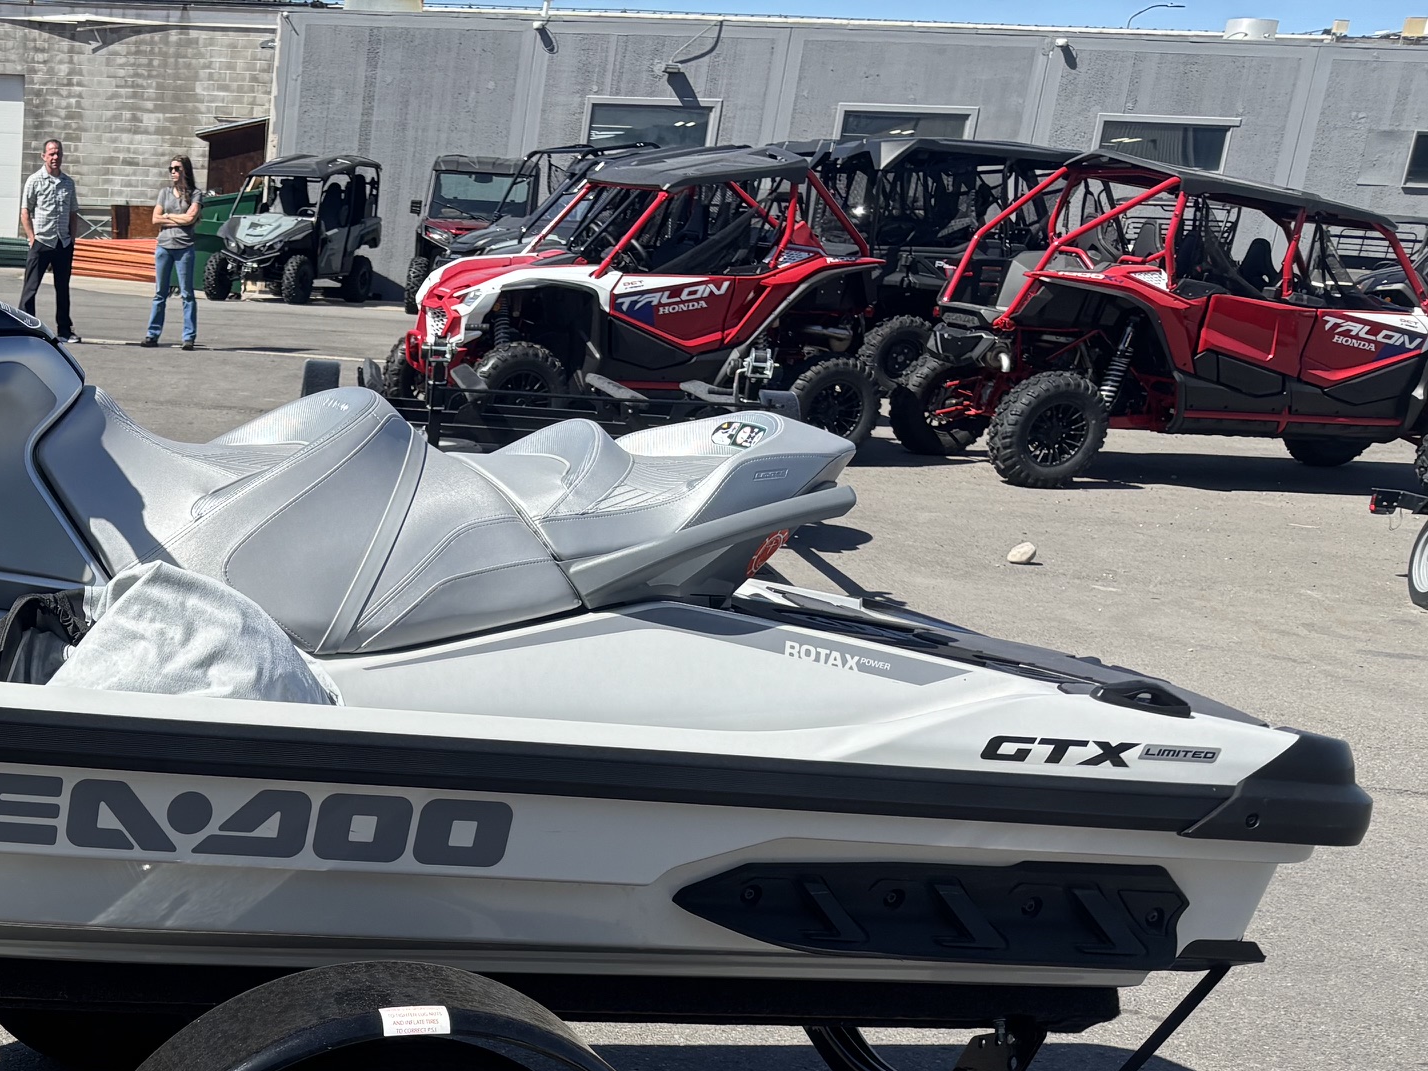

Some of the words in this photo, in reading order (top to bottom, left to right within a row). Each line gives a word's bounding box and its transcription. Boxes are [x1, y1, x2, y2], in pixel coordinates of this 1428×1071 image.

[616, 281, 731, 312] TALON
[658, 300, 708, 315] HONDA
[1322, 315, 1423, 350] TALON
[1332, 334, 1376, 352] HONDA
[784, 640, 861, 673] ROTAX
[860, 657, 891, 671] POWER
[980, 735, 1143, 768] GTX
[1144, 748, 1217, 760] LIMITED
